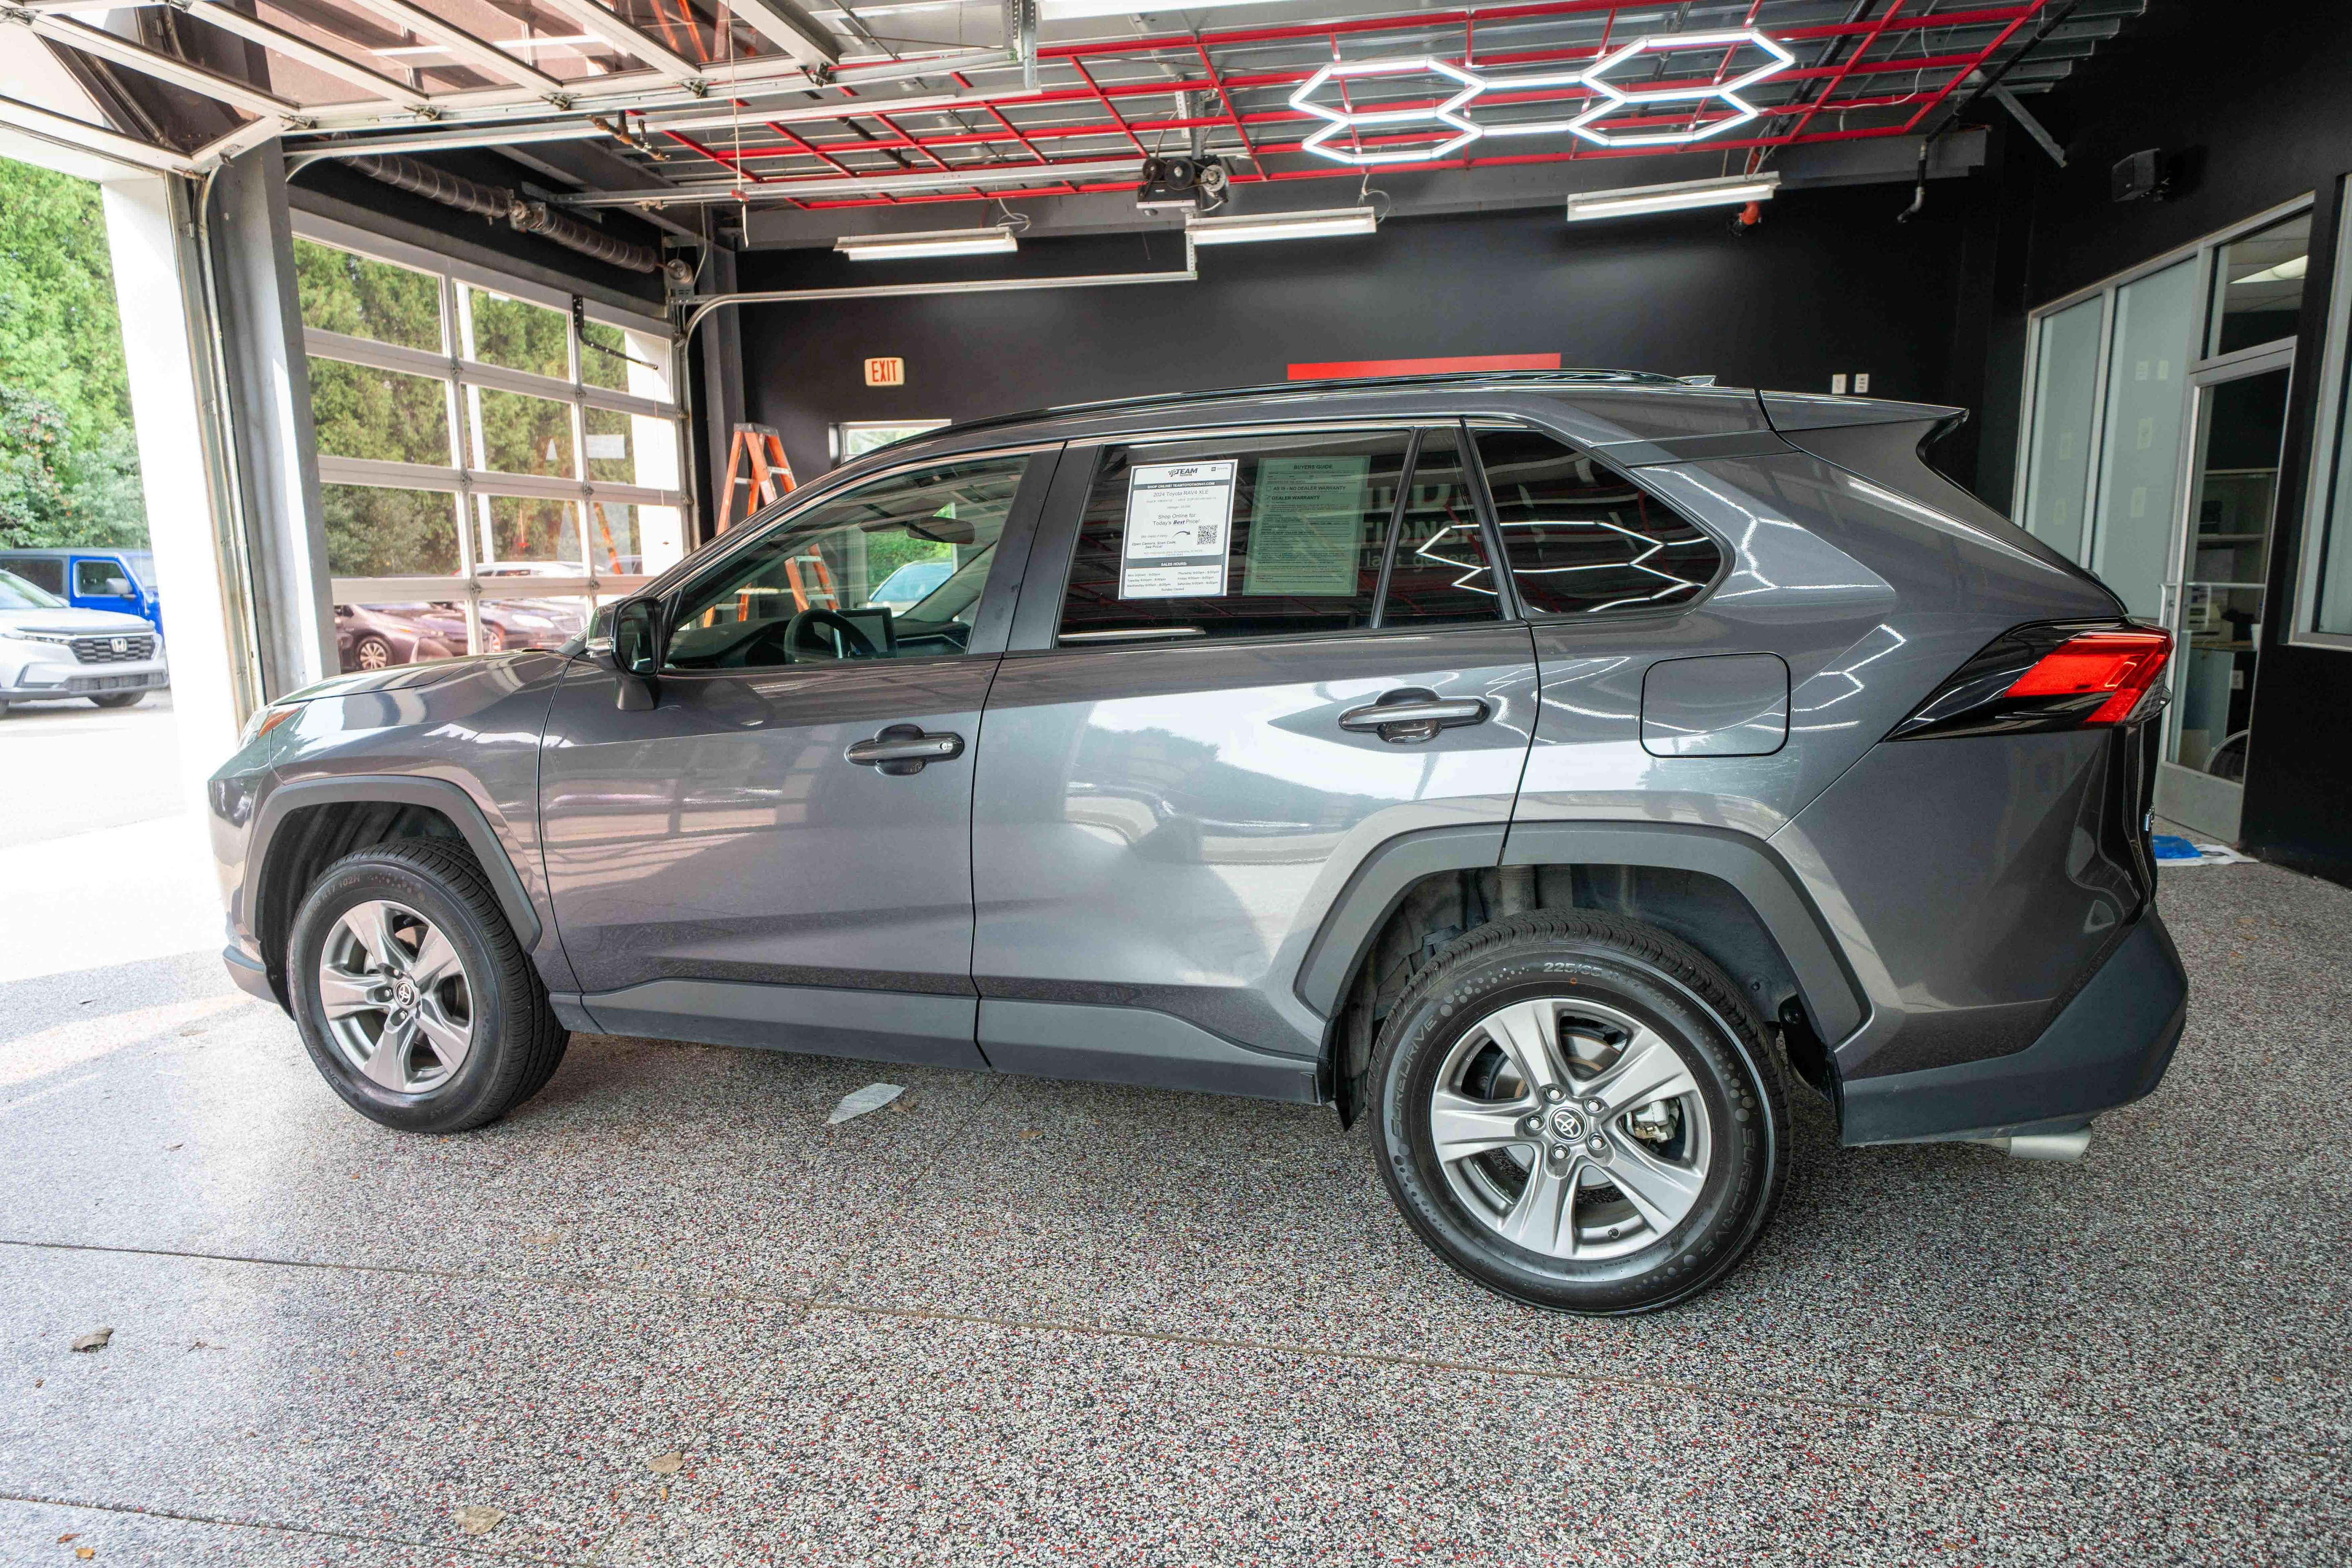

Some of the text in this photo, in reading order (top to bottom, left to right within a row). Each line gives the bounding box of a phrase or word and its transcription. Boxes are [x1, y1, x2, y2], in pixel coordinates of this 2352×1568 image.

[871, 360, 897, 382] EXIT
[340, 874, 360, 888] 102H
[1542, 962, 1603, 977] 225/65
[1391, 1015, 1437, 1138] SUREDRIVE
[1701, 1127, 1755, 1257] SUREDRIVE
